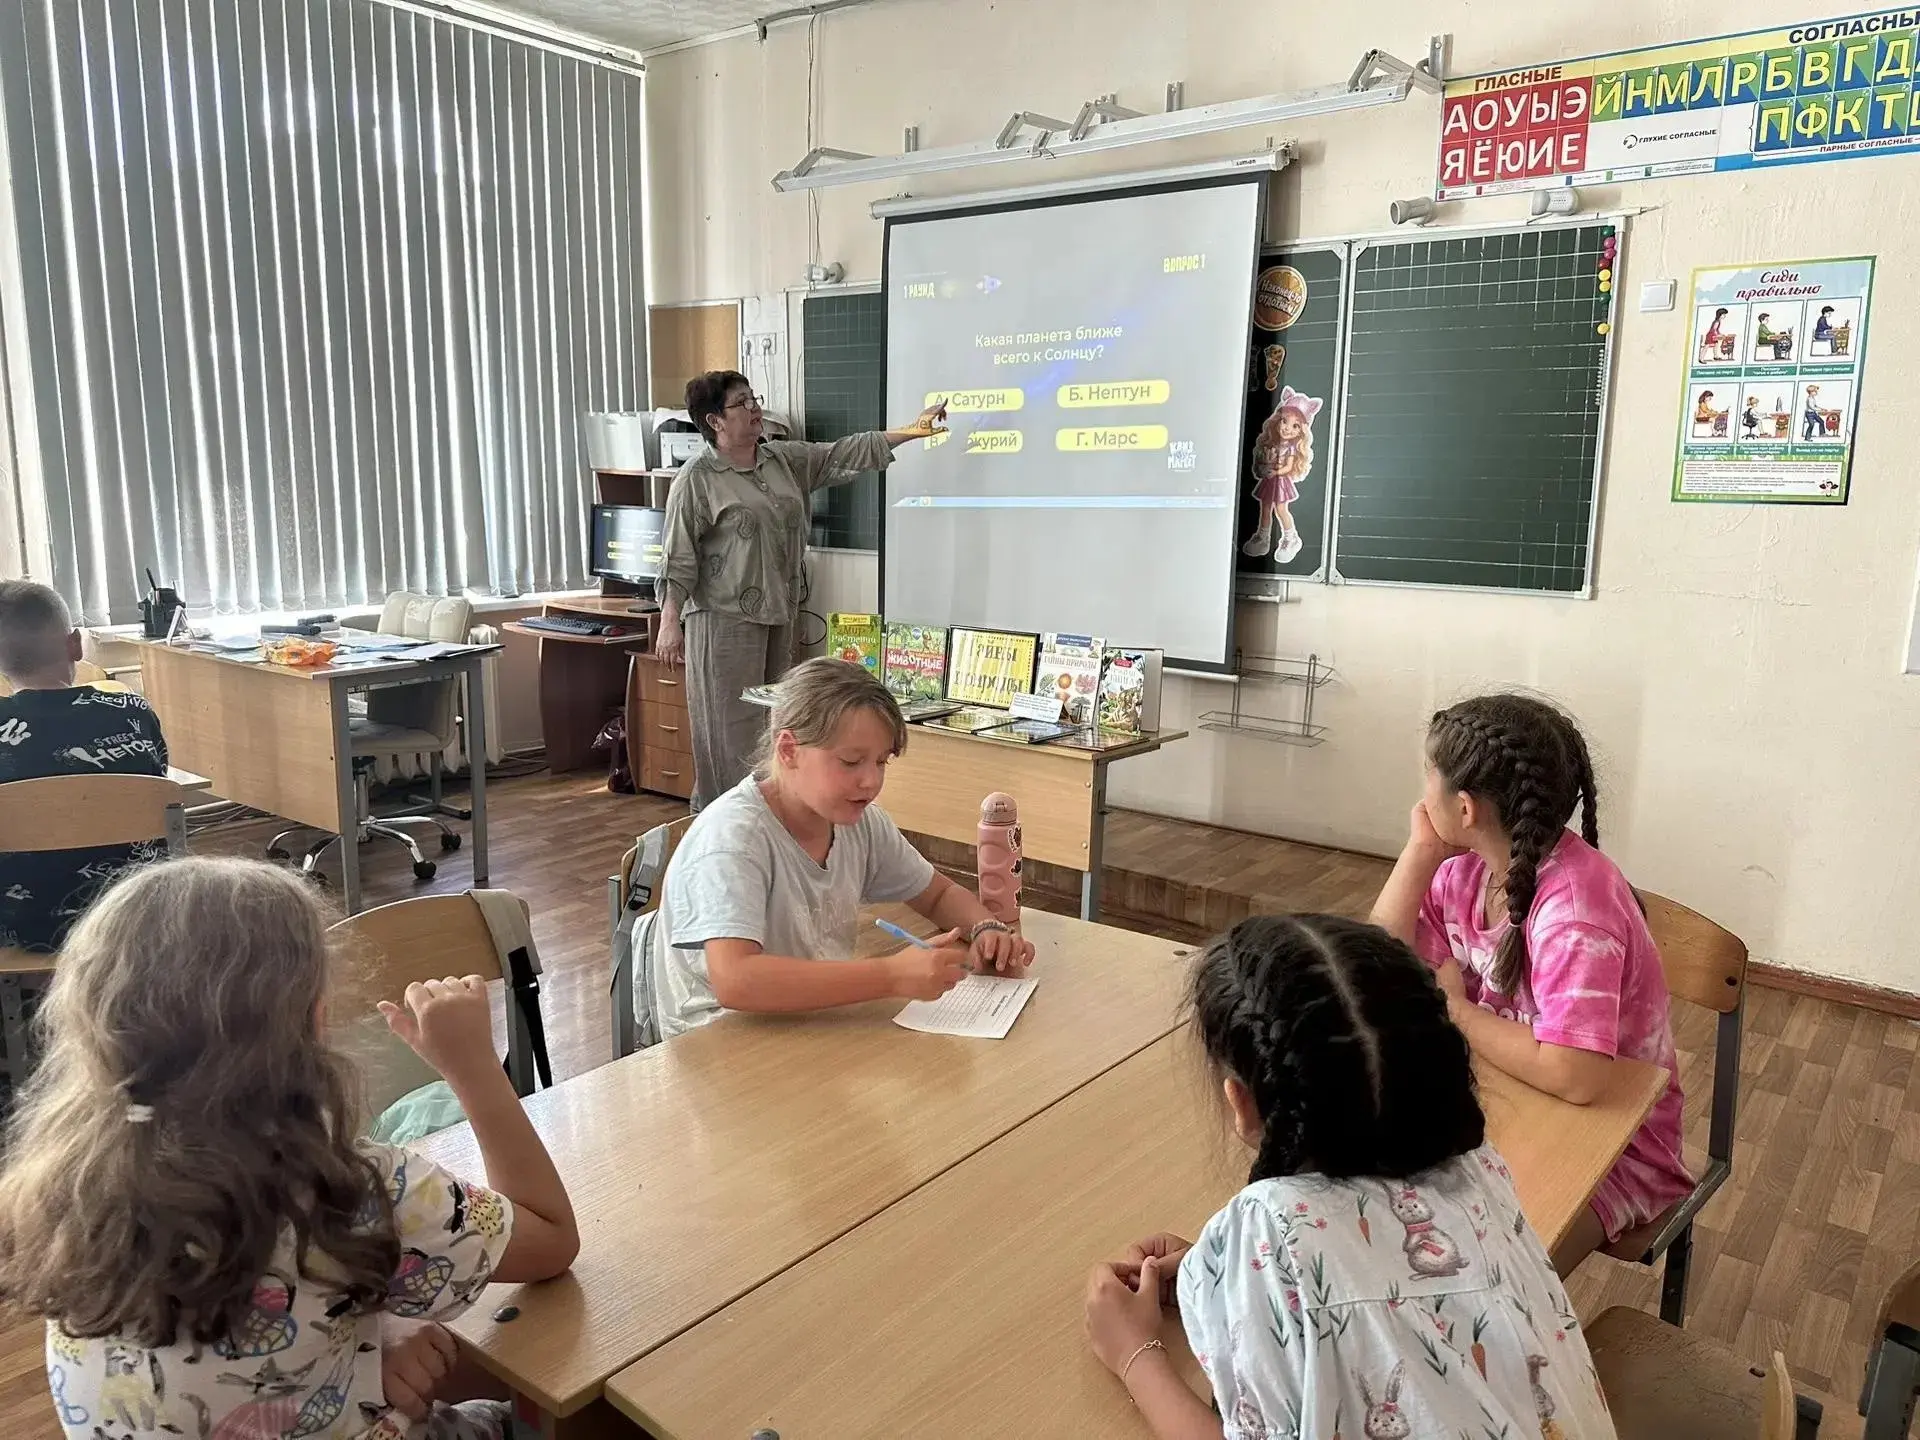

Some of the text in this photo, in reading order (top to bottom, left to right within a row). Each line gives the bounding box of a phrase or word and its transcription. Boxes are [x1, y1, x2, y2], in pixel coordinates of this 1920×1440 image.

[1474, 66, 1562, 92] ГЛАСНЫЕ
[1638, 129, 1718, 144] ГЛУХИЕ СОГЛАСНЫЕ
[1819, 137, 1914, 153] ПАРНЫЕ СОГЛАСНЫЕ
[1760, 268, 1800, 284] Сиди
[908, 282, 935, 299] РАУНД
[1736, 284, 1823, 302] правильно
[975, 325, 1123, 348] Какая планета ближе
[993, 344, 1105, 365] всего к Солнцу?
[951, 392, 1005, 408] Сатурн
[1069, 385, 1151, 401] Б. Нептун
[1076, 431, 1139, 448] Г. Марс
[94, 732, 136, 748] STREET
